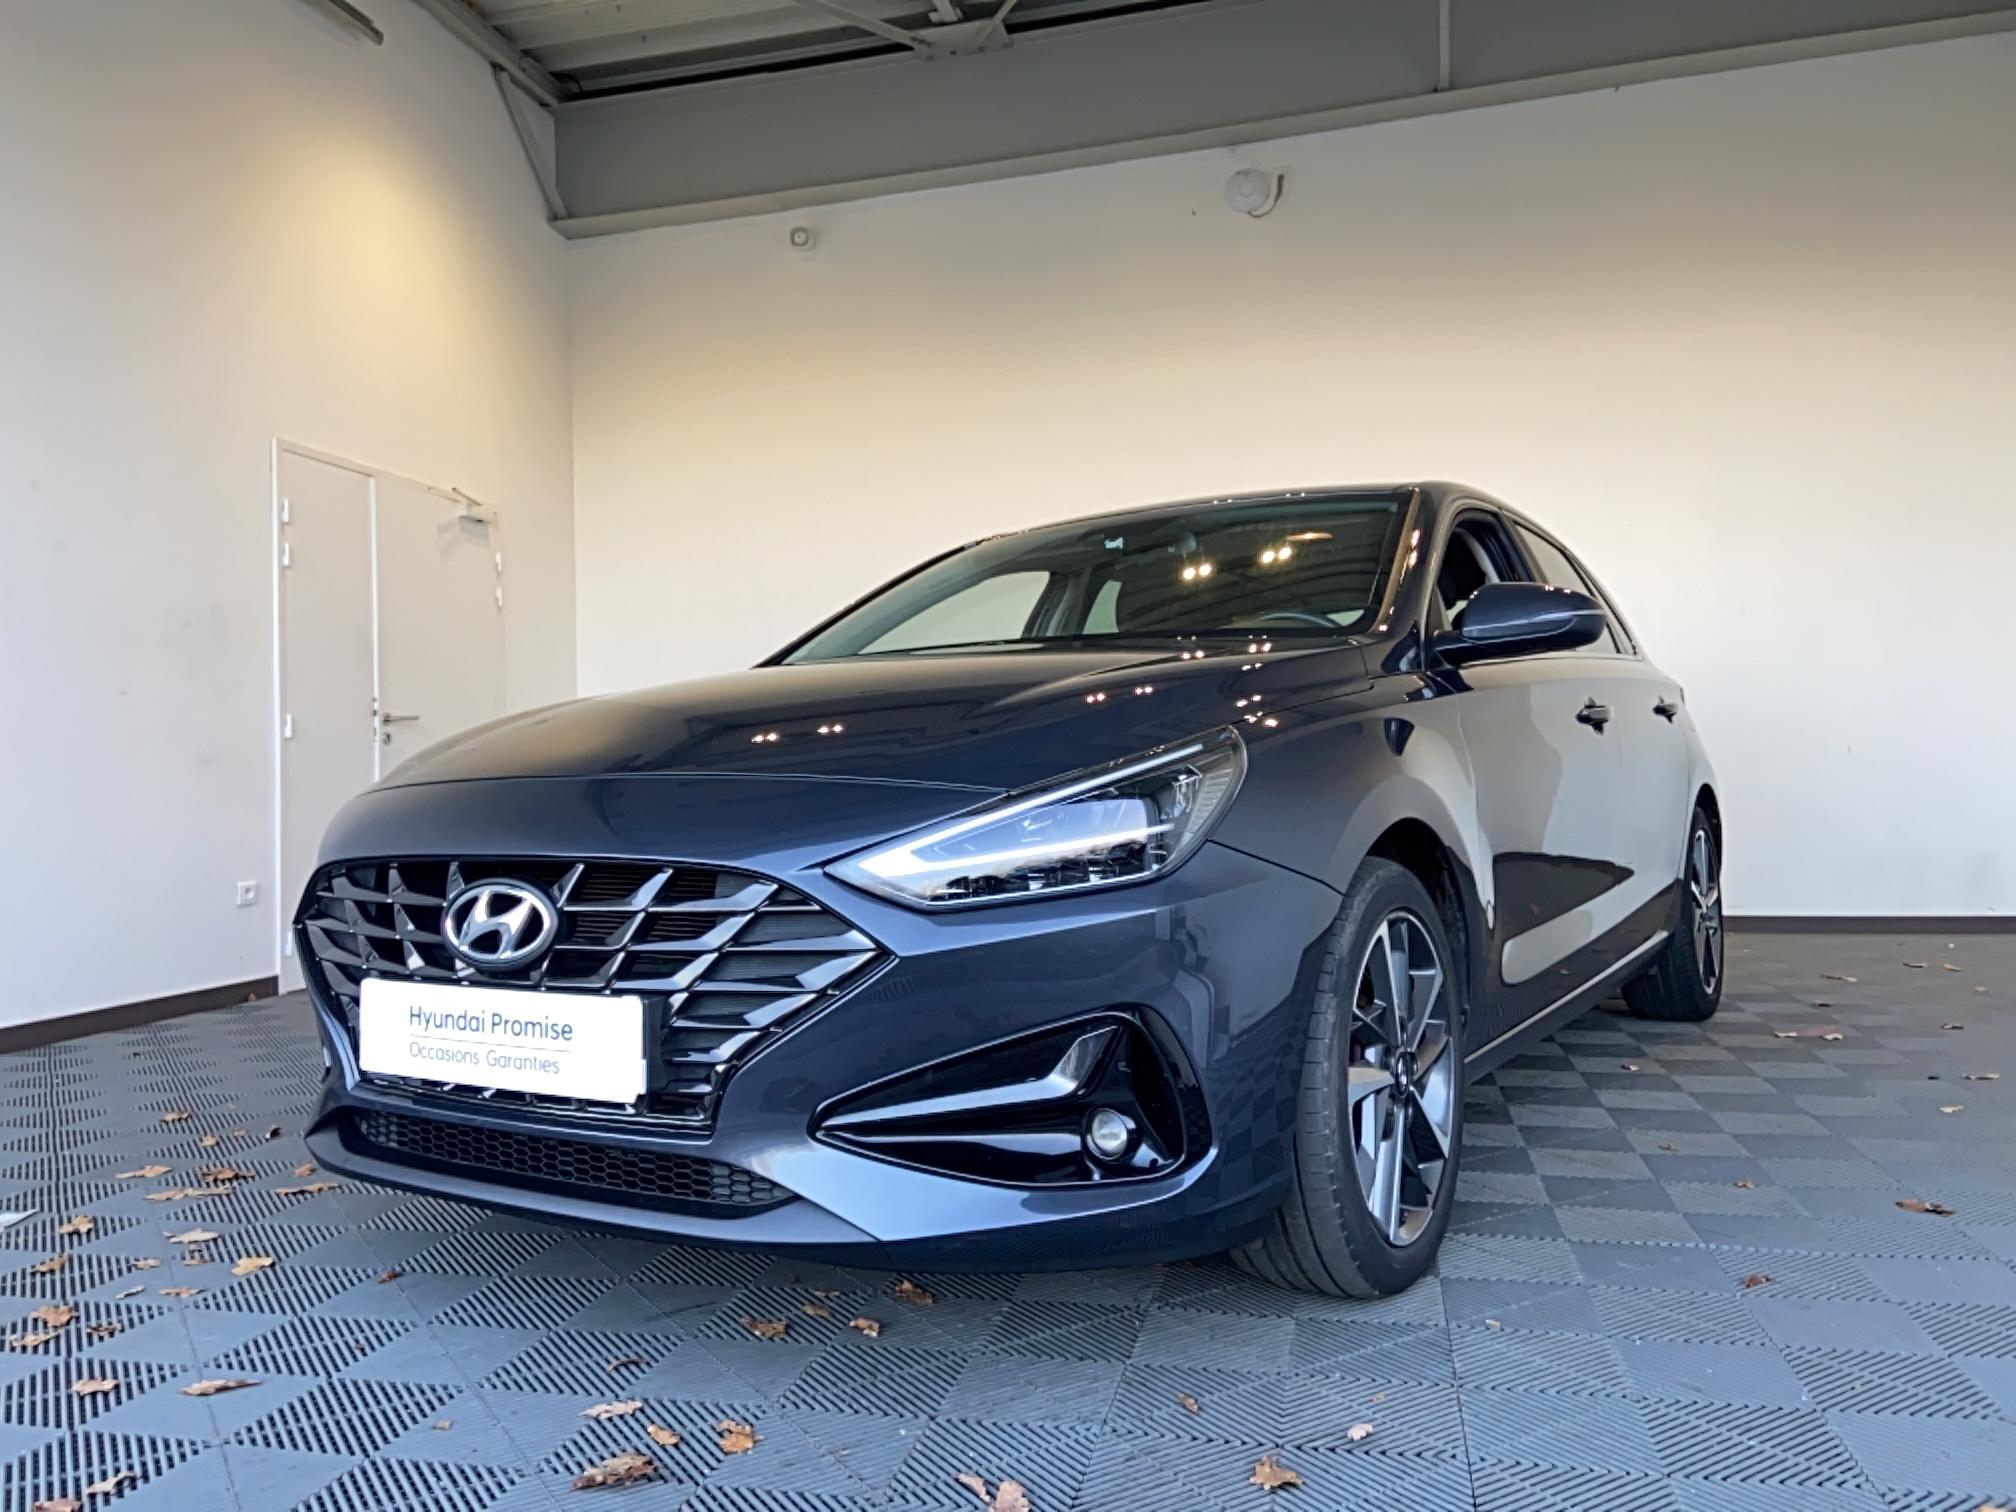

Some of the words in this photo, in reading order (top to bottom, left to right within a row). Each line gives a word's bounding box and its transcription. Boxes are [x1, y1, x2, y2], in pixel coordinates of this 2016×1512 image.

[409, 1005, 486, 1033] Hyundai
[490, 1012, 574, 1042] Promise
[409, 1041, 480, 1065] Occasions
[486, 1050, 561, 1075] Garanties
